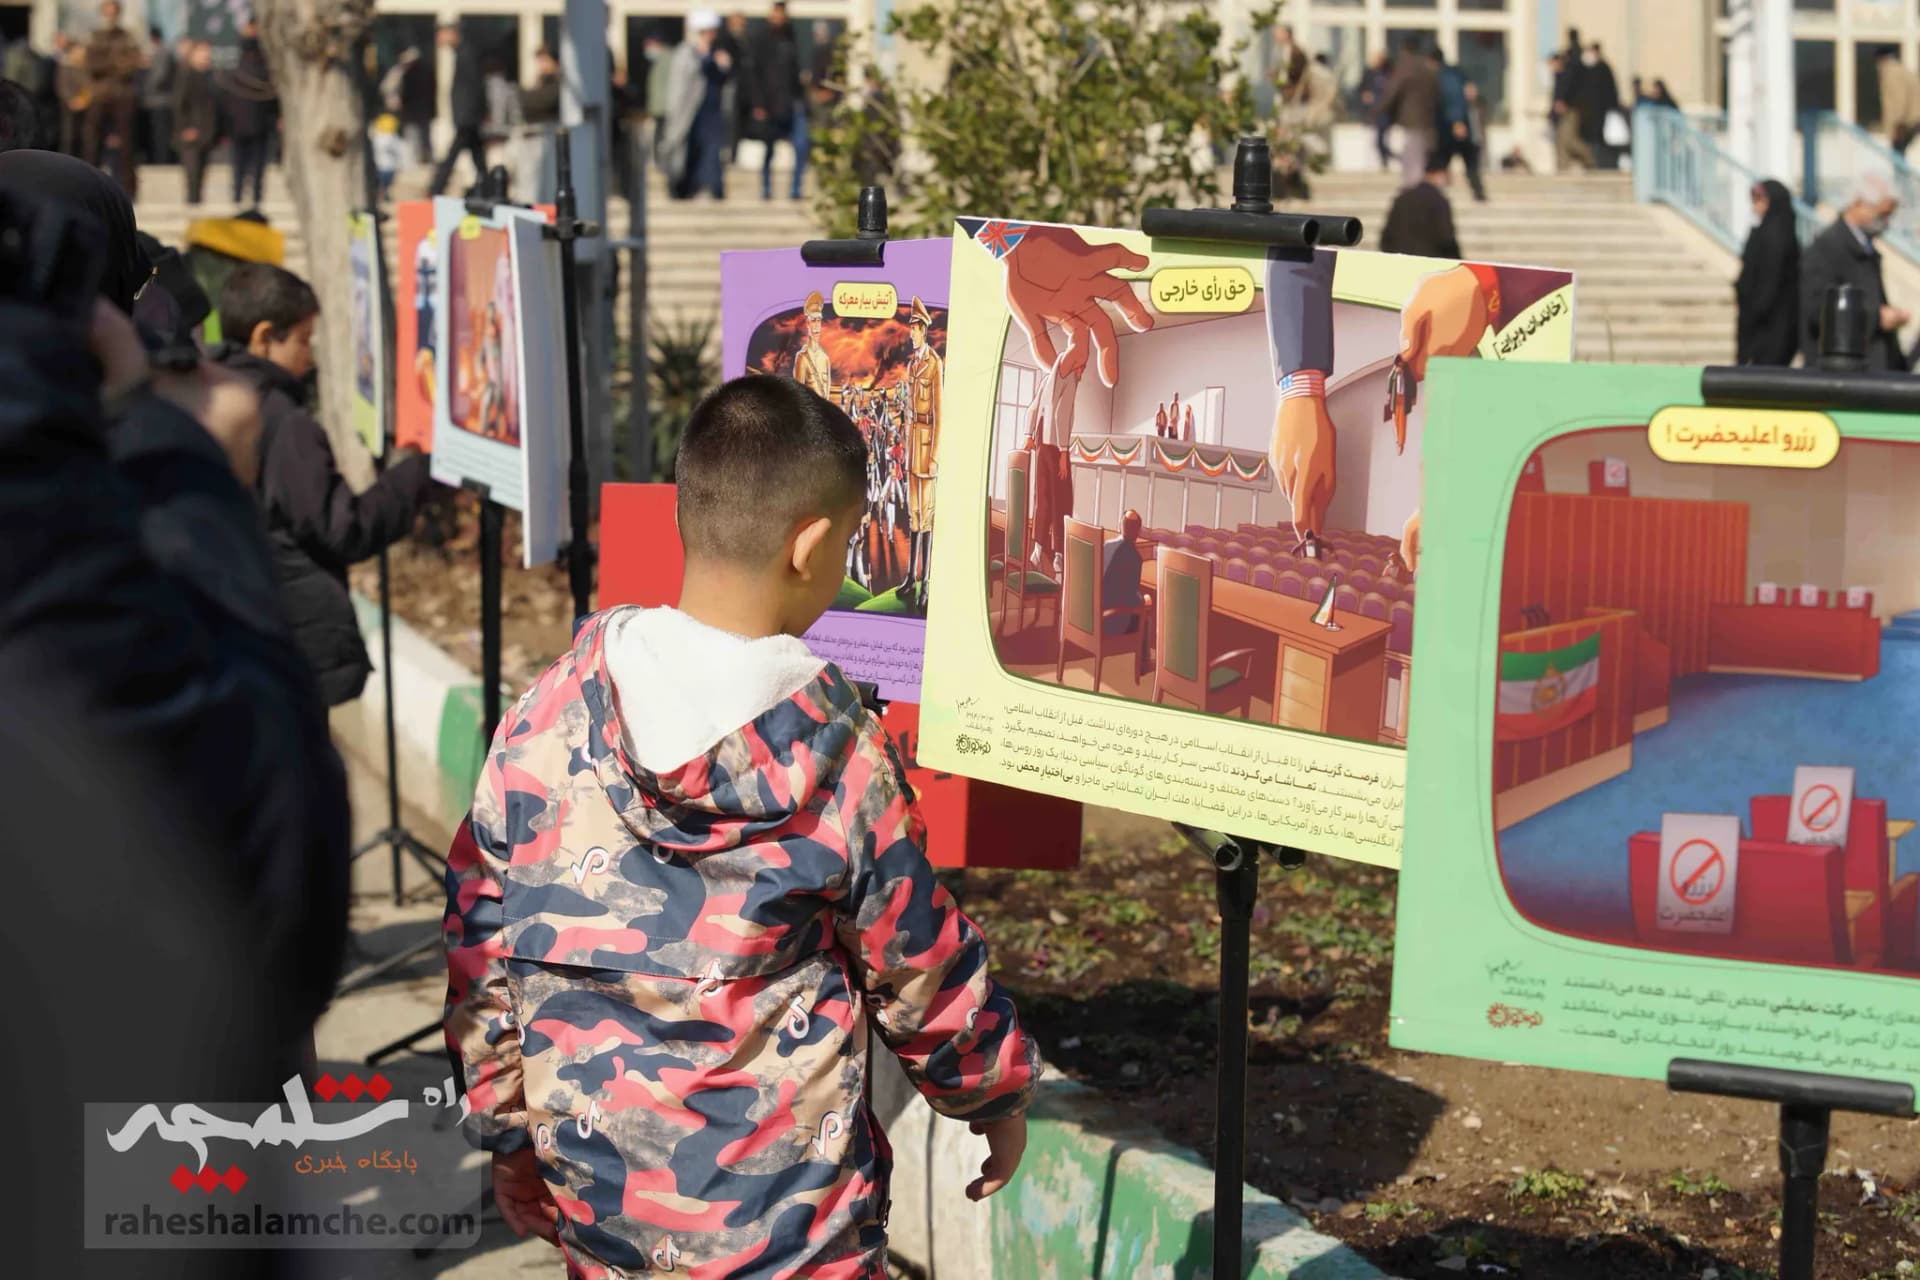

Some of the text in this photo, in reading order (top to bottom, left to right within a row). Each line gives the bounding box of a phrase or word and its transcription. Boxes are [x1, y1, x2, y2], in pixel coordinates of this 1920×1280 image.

[1160, 275, 1247, 302] حق رأی خارجی
[839, 291, 893, 310] آتیش بیار معرکه
[1782, 427, 1817, 452] رزرو
[1034, 706, 1058, 720] انقلاب
[1058, 711, 1066, 725] از
[1067, 713, 1083, 726] قبل
[1027, 726, 1056, 739] تصمیم
[1144, 731, 1169, 744] هیچ
[1168, 736, 1180, 746] در
[1180, 737, 1218, 752] اسلامی
[1032, 747, 1045, 759] روز
[1045, 747, 1060, 759] یک
[1219, 743, 1251, 758] انقلاب
[1252, 748, 1260, 763] از
[1079, 756, 1110, 768] سیاسی
[1163, 753, 1178, 764] کار
[1178, 760, 1198, 768] سر
[1260, 751, 1289, 765] قبل
[1016, 761, 1041, 773] محض
[1110, 761, 1144, 778] گوناگون
[1199, 761, 1222, 772] کسی
[1304, 760, 1342, 778] گزینش
[1081, 773, 1101, 787] ماجرا
[1274, 773, 1317, 791] تماشا
[1343, 768, 1380, 785] فرصت
[1102, 779, 1144, 795] تماشاچی
[1144, 786, 1171, 801] ایران
[1217, 784, 1247, 797] مختلف
[1172, 794, 1191, 805] ملت
[1227, 805, 1243, 818] این
[1328, 805, 1343, 818] کار
[1343, 812, 1358, 822] سر
[1308, 823, 1323, 837] روز
[1323, 823, 1340, 837] یک
[1638, 984, 1665, 997] همه
[1769, 995, 1819, 1014] نمایشی
[1822, 1002, 1857, 1020] حرکت
[1611, 1004, 1656, 1020] مجلس
[1642, 1030, 1716, 1049] انتخابات
